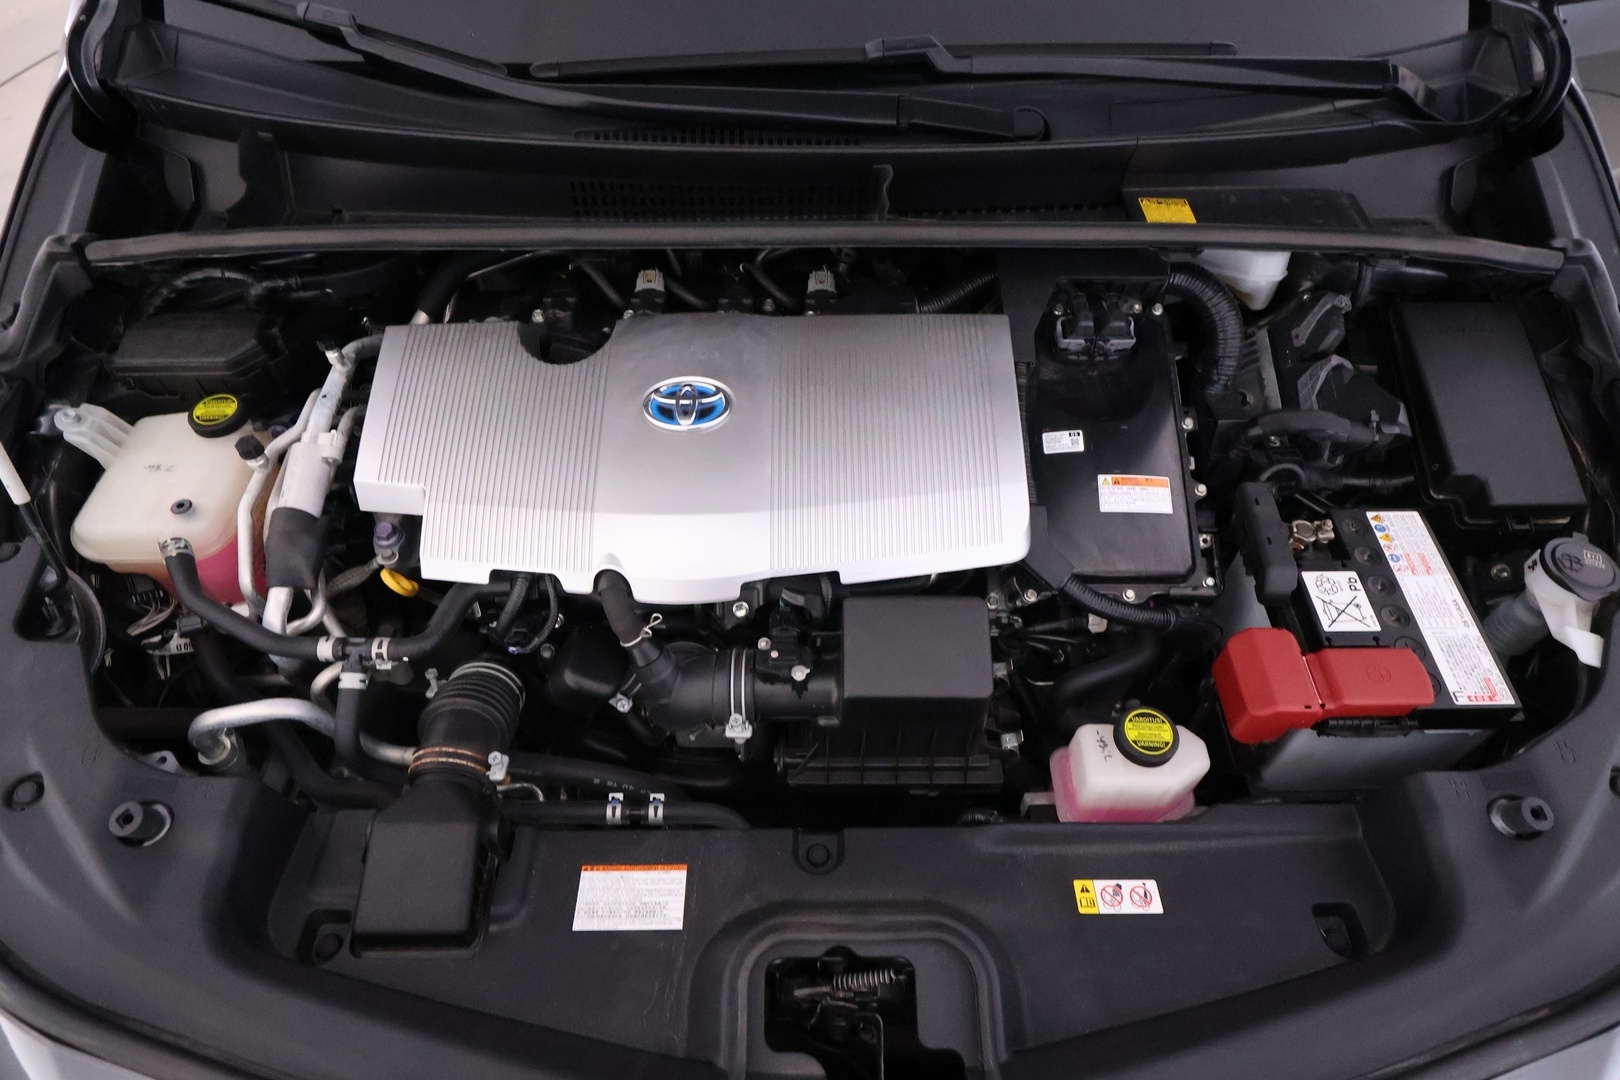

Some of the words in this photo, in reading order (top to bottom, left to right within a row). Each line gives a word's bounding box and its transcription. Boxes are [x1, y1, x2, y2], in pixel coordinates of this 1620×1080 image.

[1347, 576, 1361, 592] Pb
[1131, 716, 1163, 724] VAROITUS!
[1136, 740, 1166, 748] VARNING!
